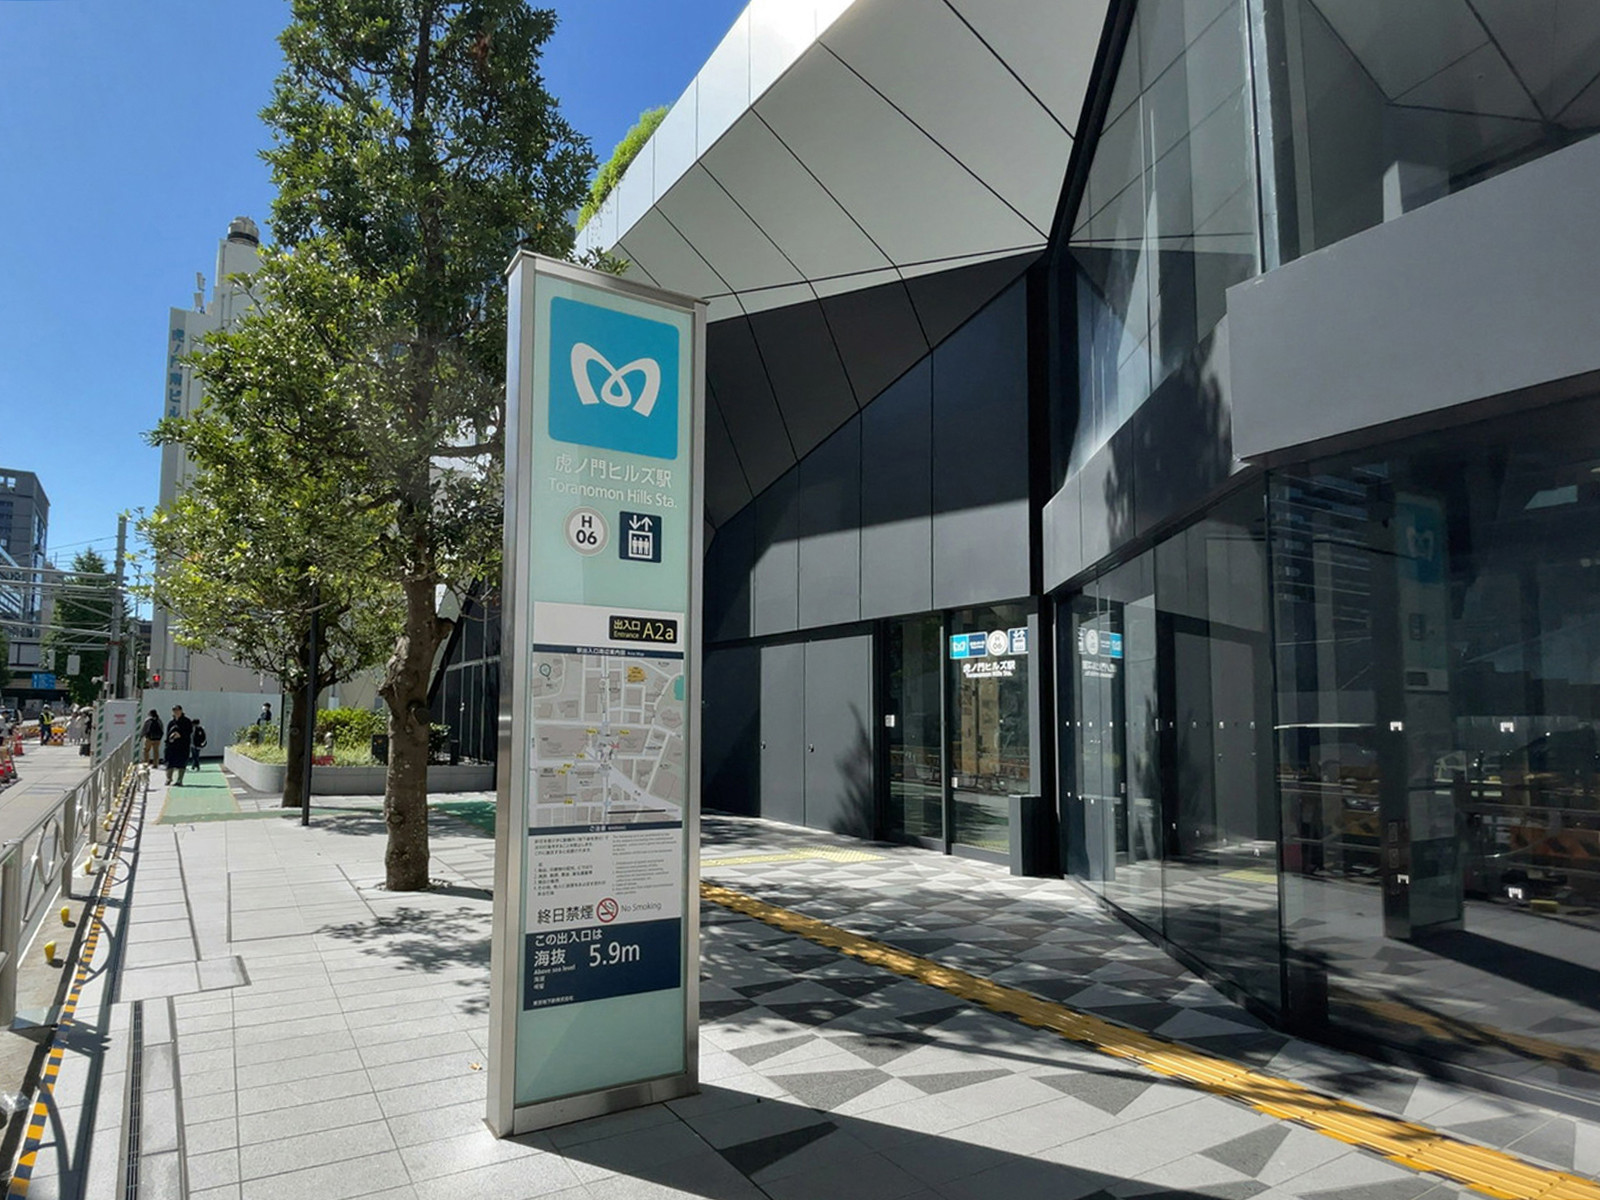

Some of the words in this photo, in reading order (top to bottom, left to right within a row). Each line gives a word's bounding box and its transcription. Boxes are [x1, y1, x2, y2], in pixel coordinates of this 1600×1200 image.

[555, 453, 672, 489] 虎ノ門ヒルズ駅
[547, 476, 624, 501] Toranomon
[627, 488, 653, 505] Hills
[655, 492, 678, 508] Sta.
[582, 515, 593, 529] H
[576, 529, 597, 545] 06
[613, 619, 641, 630] 出入口
[642, 622, 674, 640] A2a
[613, 631, 640, 639] Entrance
[537, 904, 594, 925] 終日禁煙
[621, 904, 632, 913] No
[632, 901, 662, 912] Smoking
[535, 929, 603, 947] この出入口は
[534, 948, 566, 967] 海抜
[589, 941, 640, 968] 5.9m
